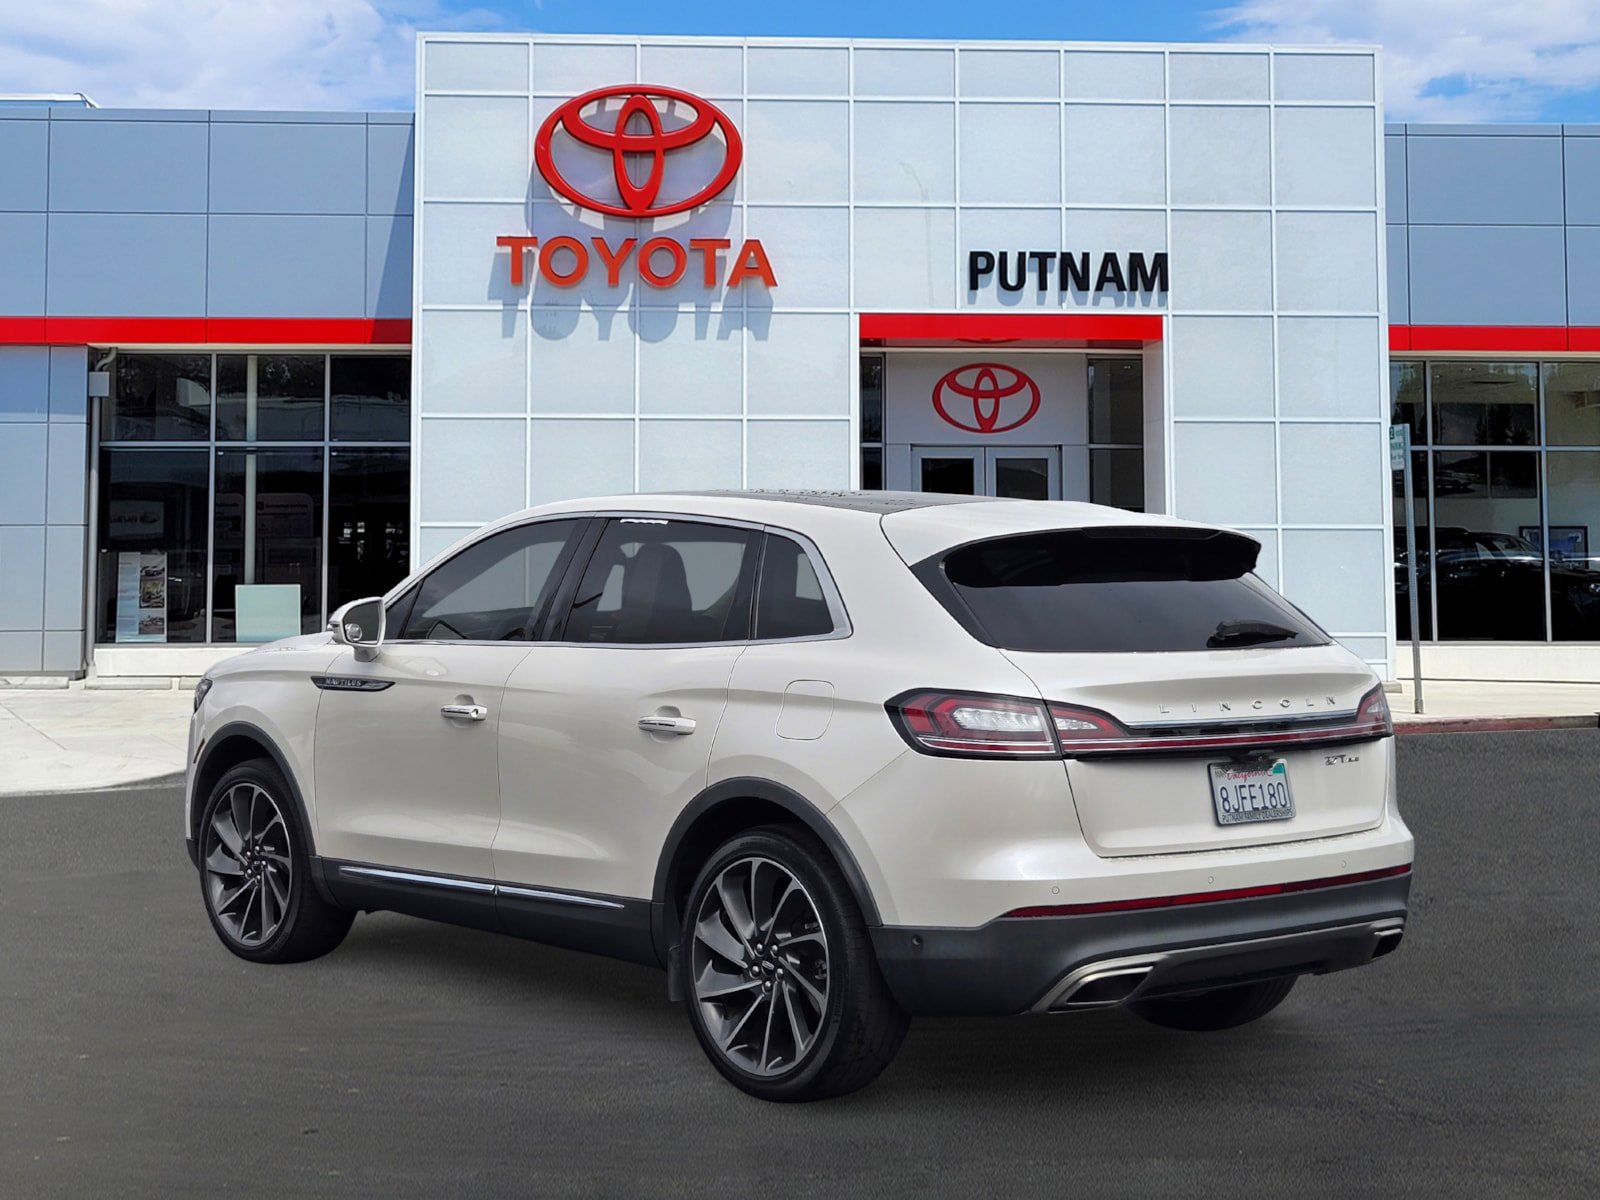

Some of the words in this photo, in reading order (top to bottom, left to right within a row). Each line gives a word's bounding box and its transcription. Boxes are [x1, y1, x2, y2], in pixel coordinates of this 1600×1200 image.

[496, 236, 778, 287] TOYOTA
[969, 251, 1169, 291] PUTNAM
[326, 678, 361, 686] NAUTILUS
[1159, 696, 1337, 714] LINCOLN
[1220, 782, 1287, 813] 8JFE180
[1222, 812, 1243, 823] PUTNAM
